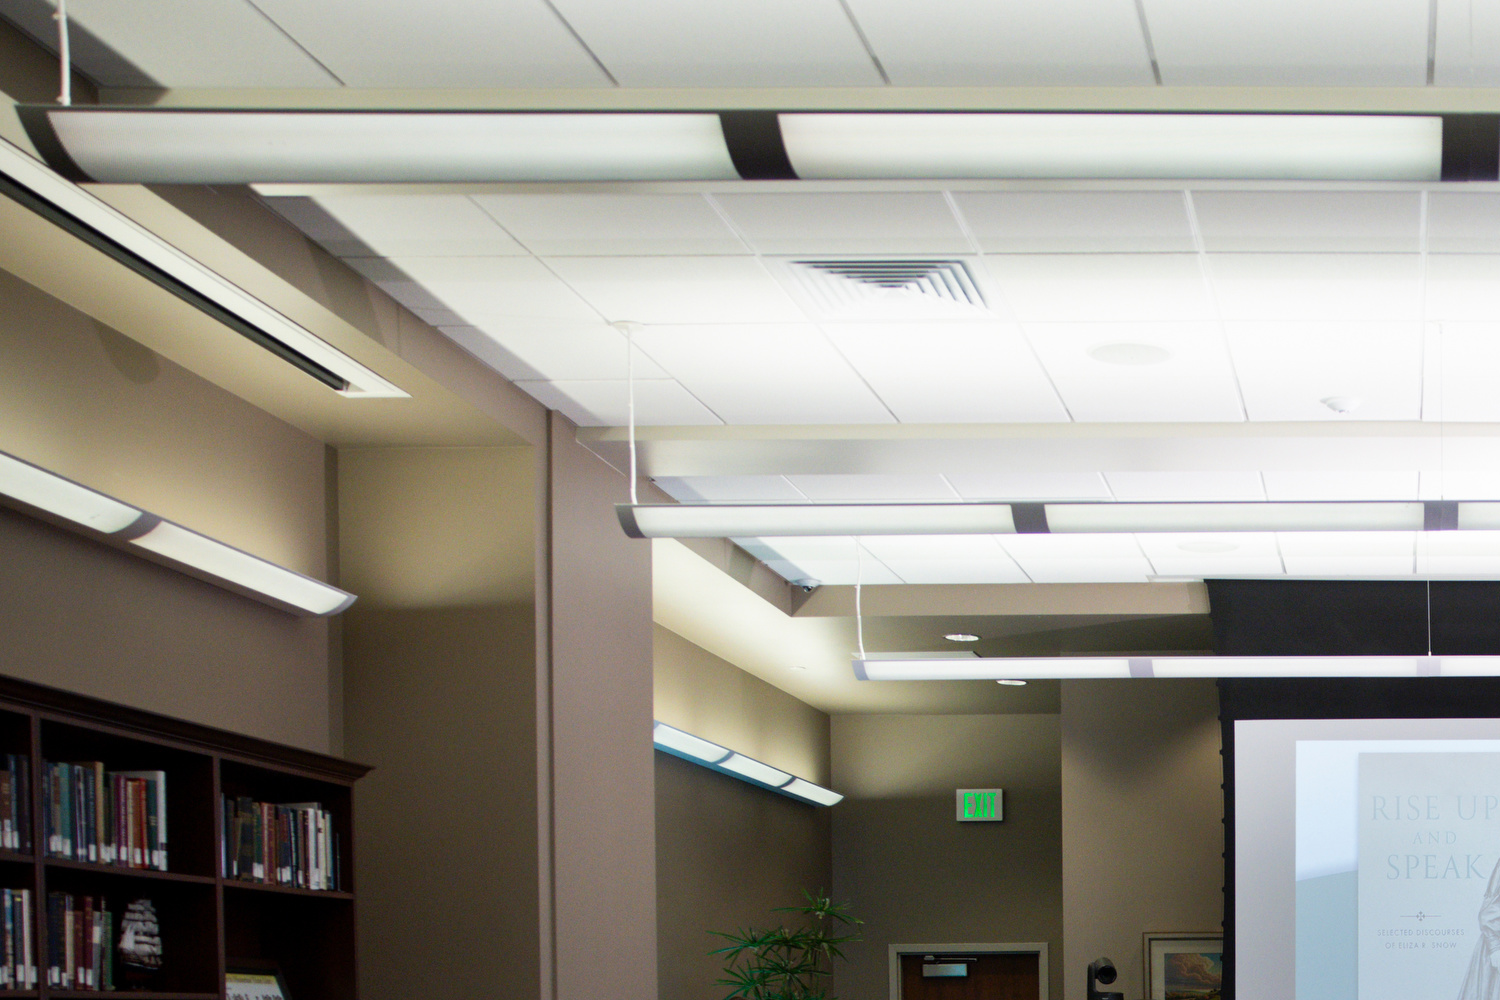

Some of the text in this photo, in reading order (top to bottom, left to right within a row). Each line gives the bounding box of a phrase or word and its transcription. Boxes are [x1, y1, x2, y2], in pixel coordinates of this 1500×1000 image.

[963, 793, 997, 818] EXIT
[1372, 795, 1499, 820] RISE UP
[1413, 831, 1457, 844] AND
[1386, 854, 1487, 880] SPEAK
[1416, 928, 1465, 936] DISCOURSES
